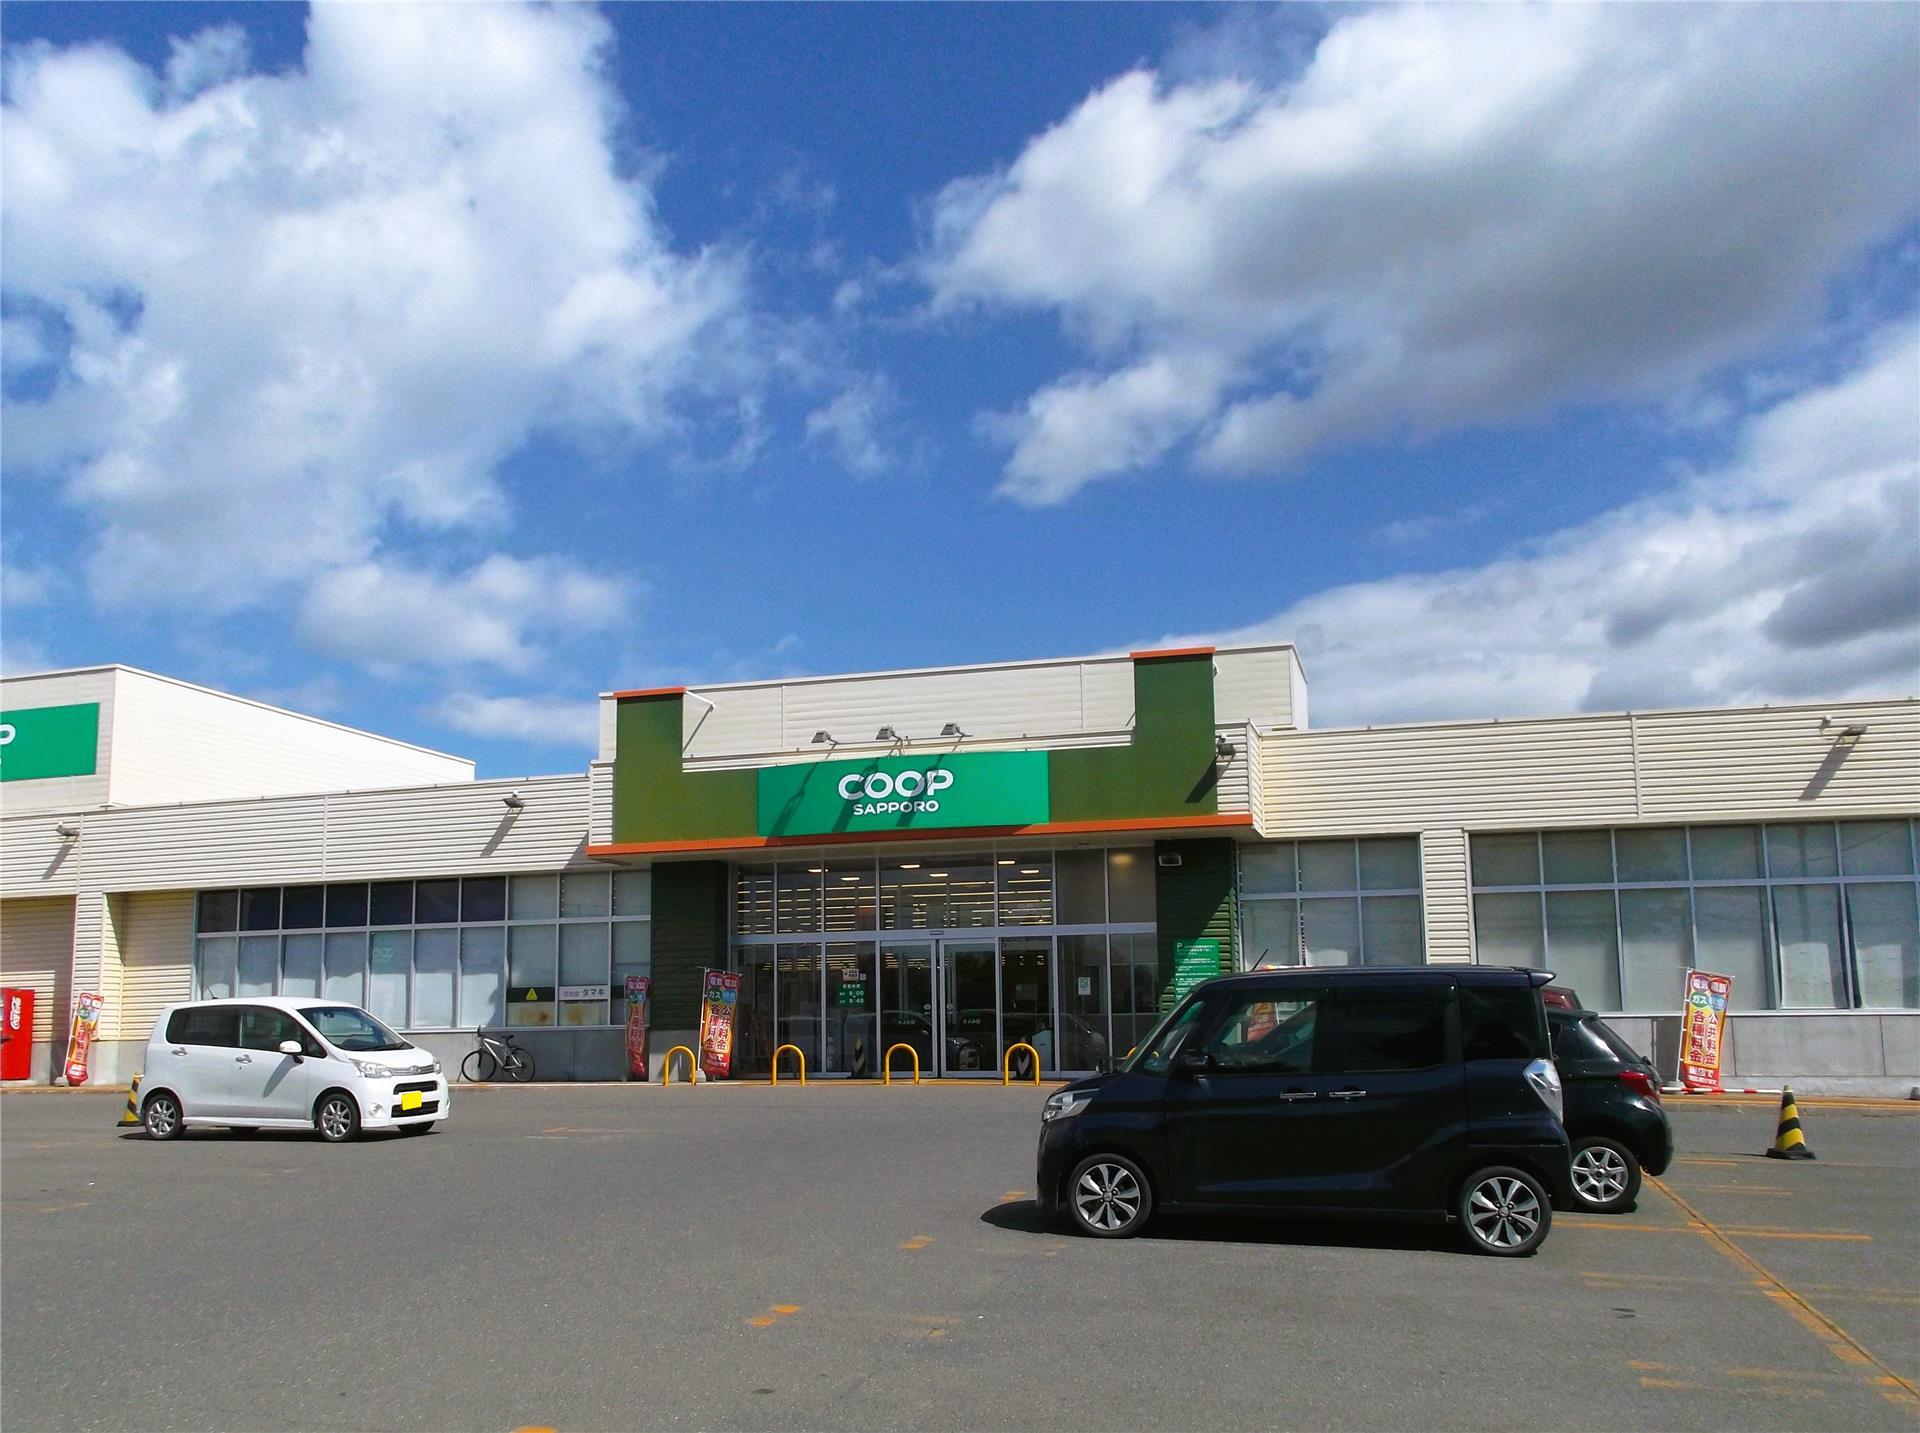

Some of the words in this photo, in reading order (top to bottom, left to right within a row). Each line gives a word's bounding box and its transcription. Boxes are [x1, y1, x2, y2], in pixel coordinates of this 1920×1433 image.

[838, 769, 954, 800] COOP
[853, 800, 939, 816] SAPPORO
[582, 988, 605, 997] タマキ
[709, 990, 721, 999] ガス
[1691, 995, 1708, 1004] ガス
[1689, 1010, 1705, 1063] 各種料金
[1705, 1012, 1718, 1065] 公共料金
